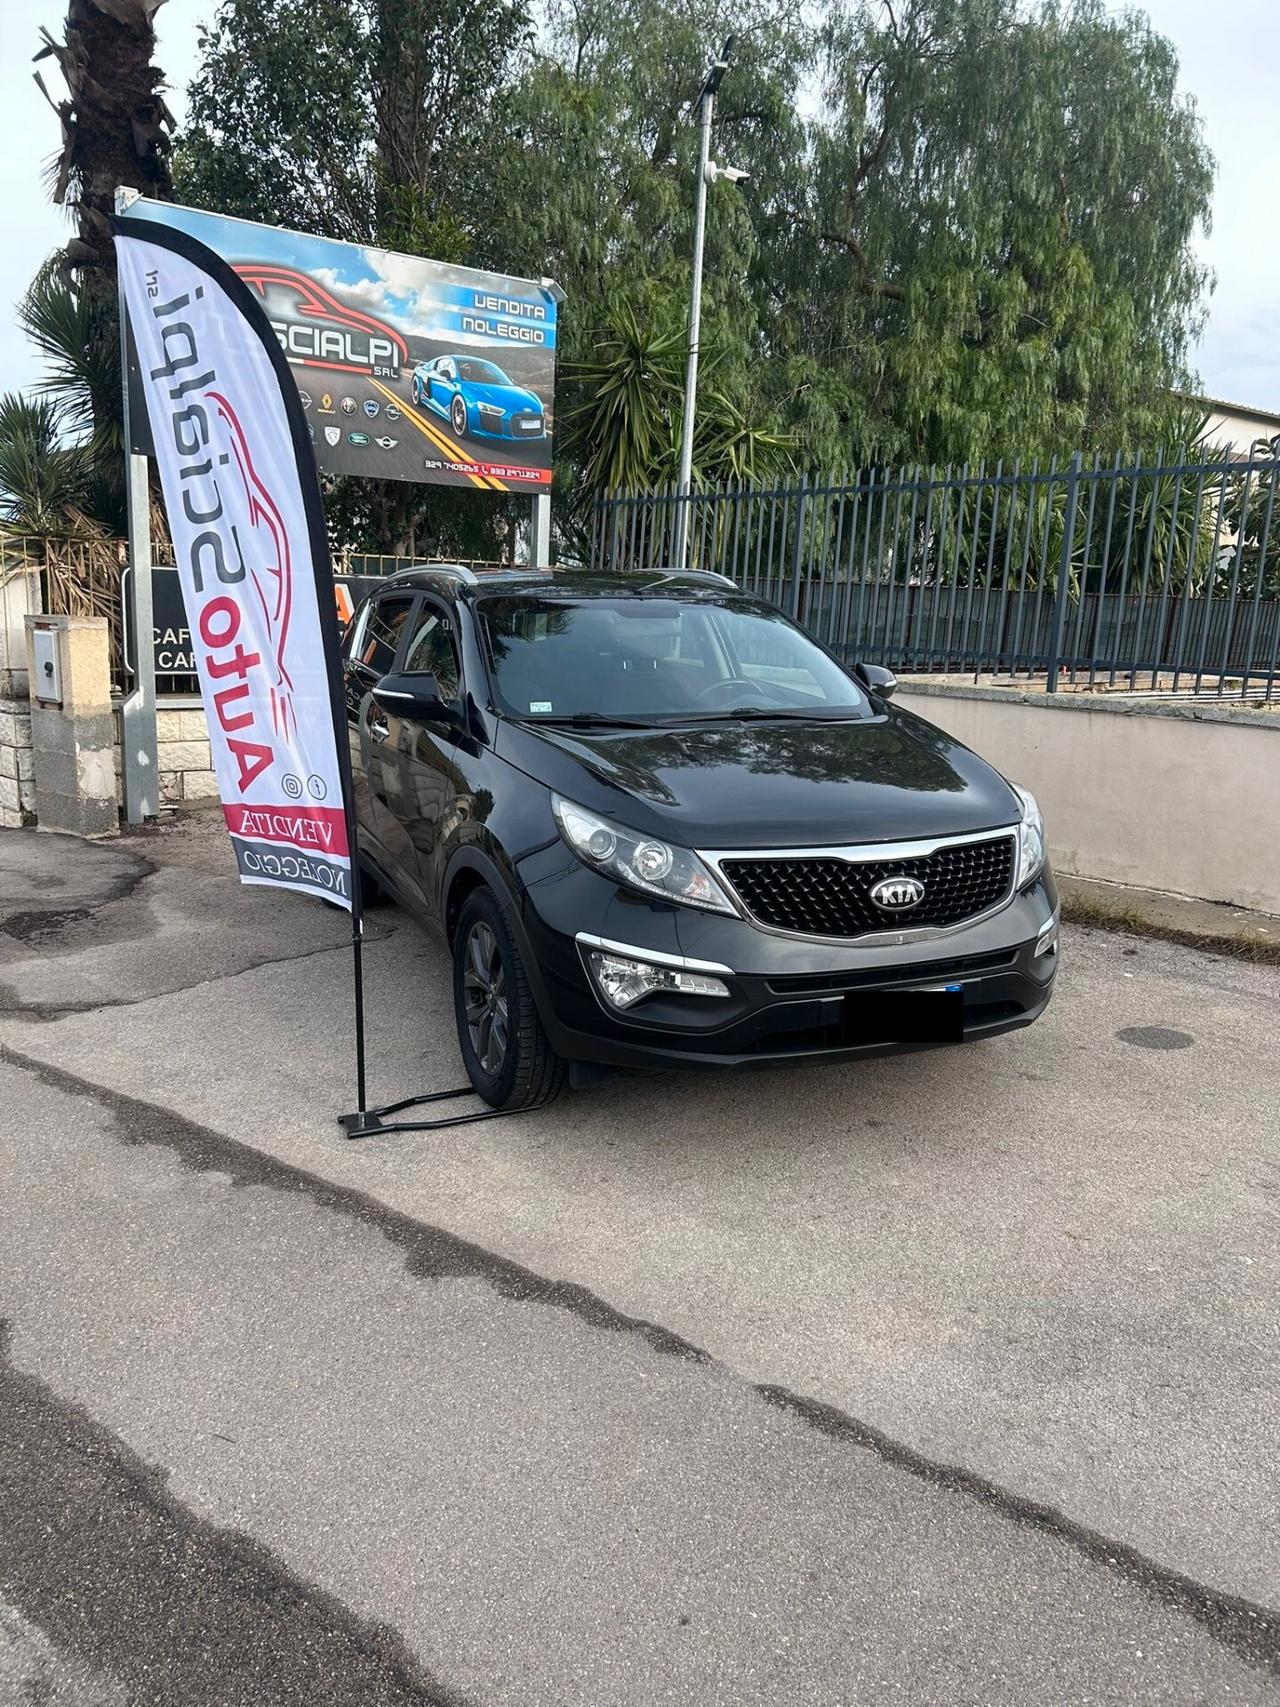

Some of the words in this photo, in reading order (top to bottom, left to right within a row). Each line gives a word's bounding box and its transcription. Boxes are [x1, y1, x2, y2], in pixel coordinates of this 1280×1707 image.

[474, 294, 545, 320] VENDITA
[463, 317, 545, 343] NOLEGGIO
[881, 884, 918, 905] KIA
